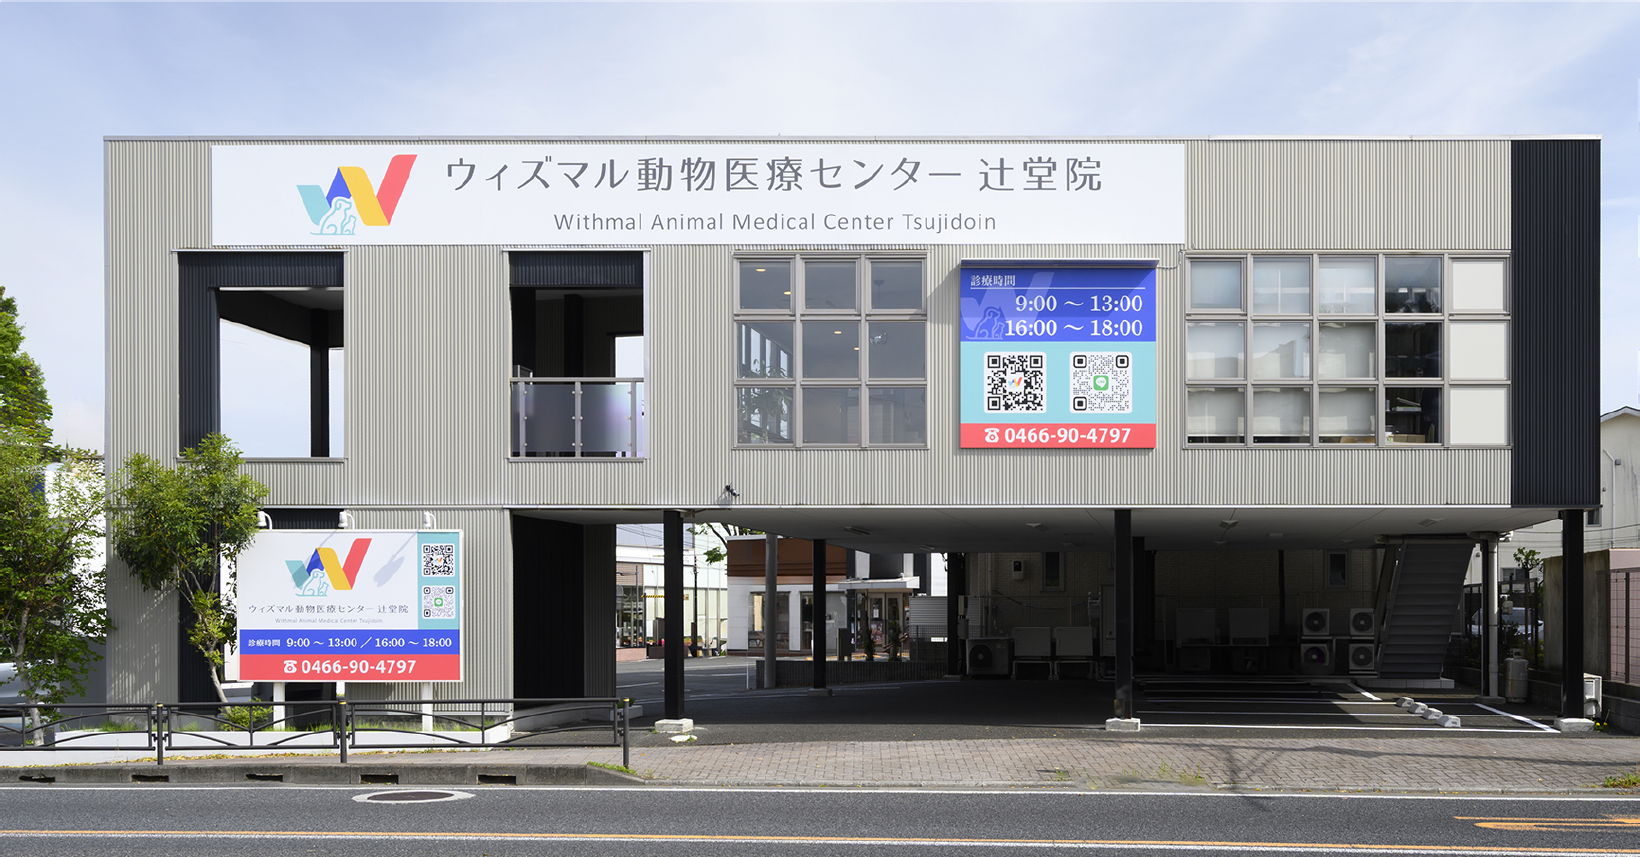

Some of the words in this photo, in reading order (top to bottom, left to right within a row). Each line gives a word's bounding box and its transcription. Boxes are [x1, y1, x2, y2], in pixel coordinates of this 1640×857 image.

[446, 155, 962, 192] ウィズマル動物医療センター
[978, 155, 1103, 192] 辻堂院
[553, 212, 642, 231] Withmal
[650, 212, 723, 231] Animal
[732, 212, 815, 231] Medical
[823, 213, 894, 231] Center
[902, 212, 996, 234] Tsujidoin
[970, 275, 1016, 287] 診療時間
[1015, 295, 1057, 312] 9:00
[1090, 295, 1143, 312] 13:00
[1005, 319, 1058, 337] 16:00
[1090, 319, 1143, 337] 18:00
[1004, 427, 1131, 444] 0466-90-4797
[248, 604, 374, 614] ウィズマル動物医療センター
[377, 604, 409, 614] 辻堂院
[274, 617, 298, 625] Withmal
[298, 617, 317, 625] Animal
[318, 617, 339, 625] Medical
[340, 617, 358, 625] Center
[359, 617, 383, 625] Tsujidoin
[248, 638, 281, 647] 診療時間
[286, 637, 311, 648] 9:00
[327, 637, 358, 648] 13:00
[375, 637, 406, 648] 16:00
[423, 637, 452, 648] 18:00
[301, 659, 417, 674] 0466-90-4797
